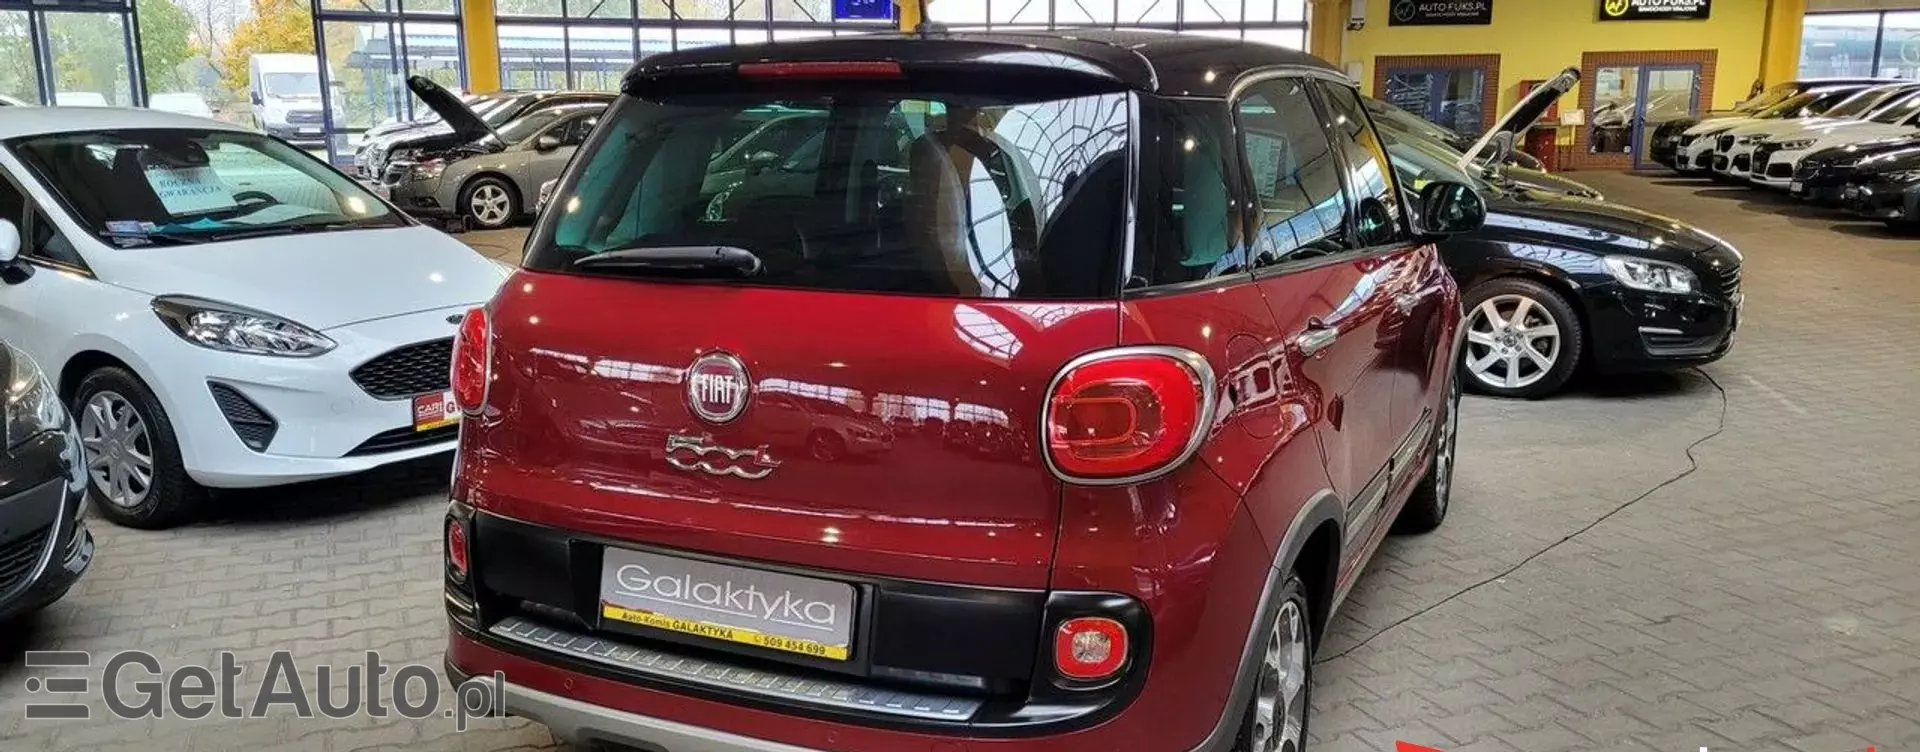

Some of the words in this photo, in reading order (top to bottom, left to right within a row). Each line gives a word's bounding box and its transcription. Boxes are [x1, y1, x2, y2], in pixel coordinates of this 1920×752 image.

[1419, 3, 1446, 12] AUTO
[701, 373, 734, 404] FIAT
[616, 564, 836, 624] Galaktyka
[672, 620, 734, 639] GALAKTYKA
[763, 635, 783, 646] 509
[806, 643, 826, 655] 699
